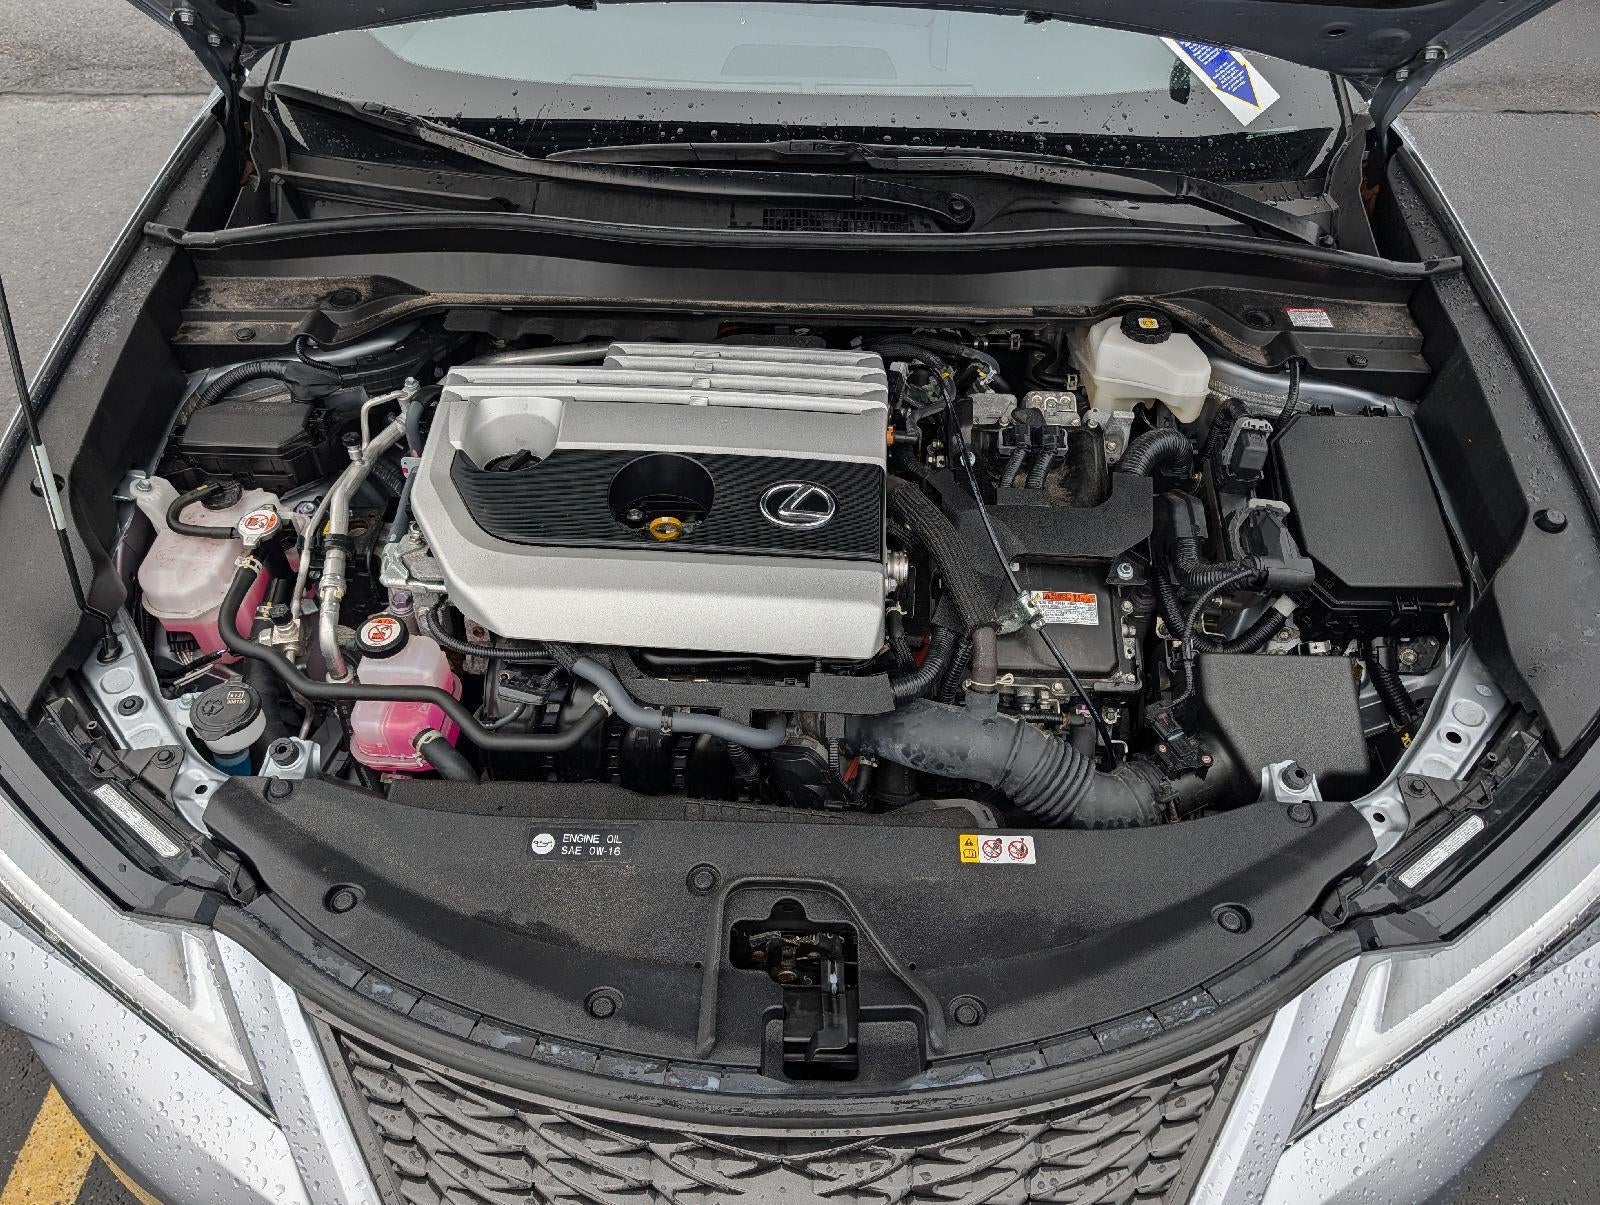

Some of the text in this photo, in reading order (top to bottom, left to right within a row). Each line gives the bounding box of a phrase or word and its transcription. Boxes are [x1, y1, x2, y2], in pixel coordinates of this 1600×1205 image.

[562, 833, 623, 844] ENGINE OIL
[561, 845, 582, 855] SAE
